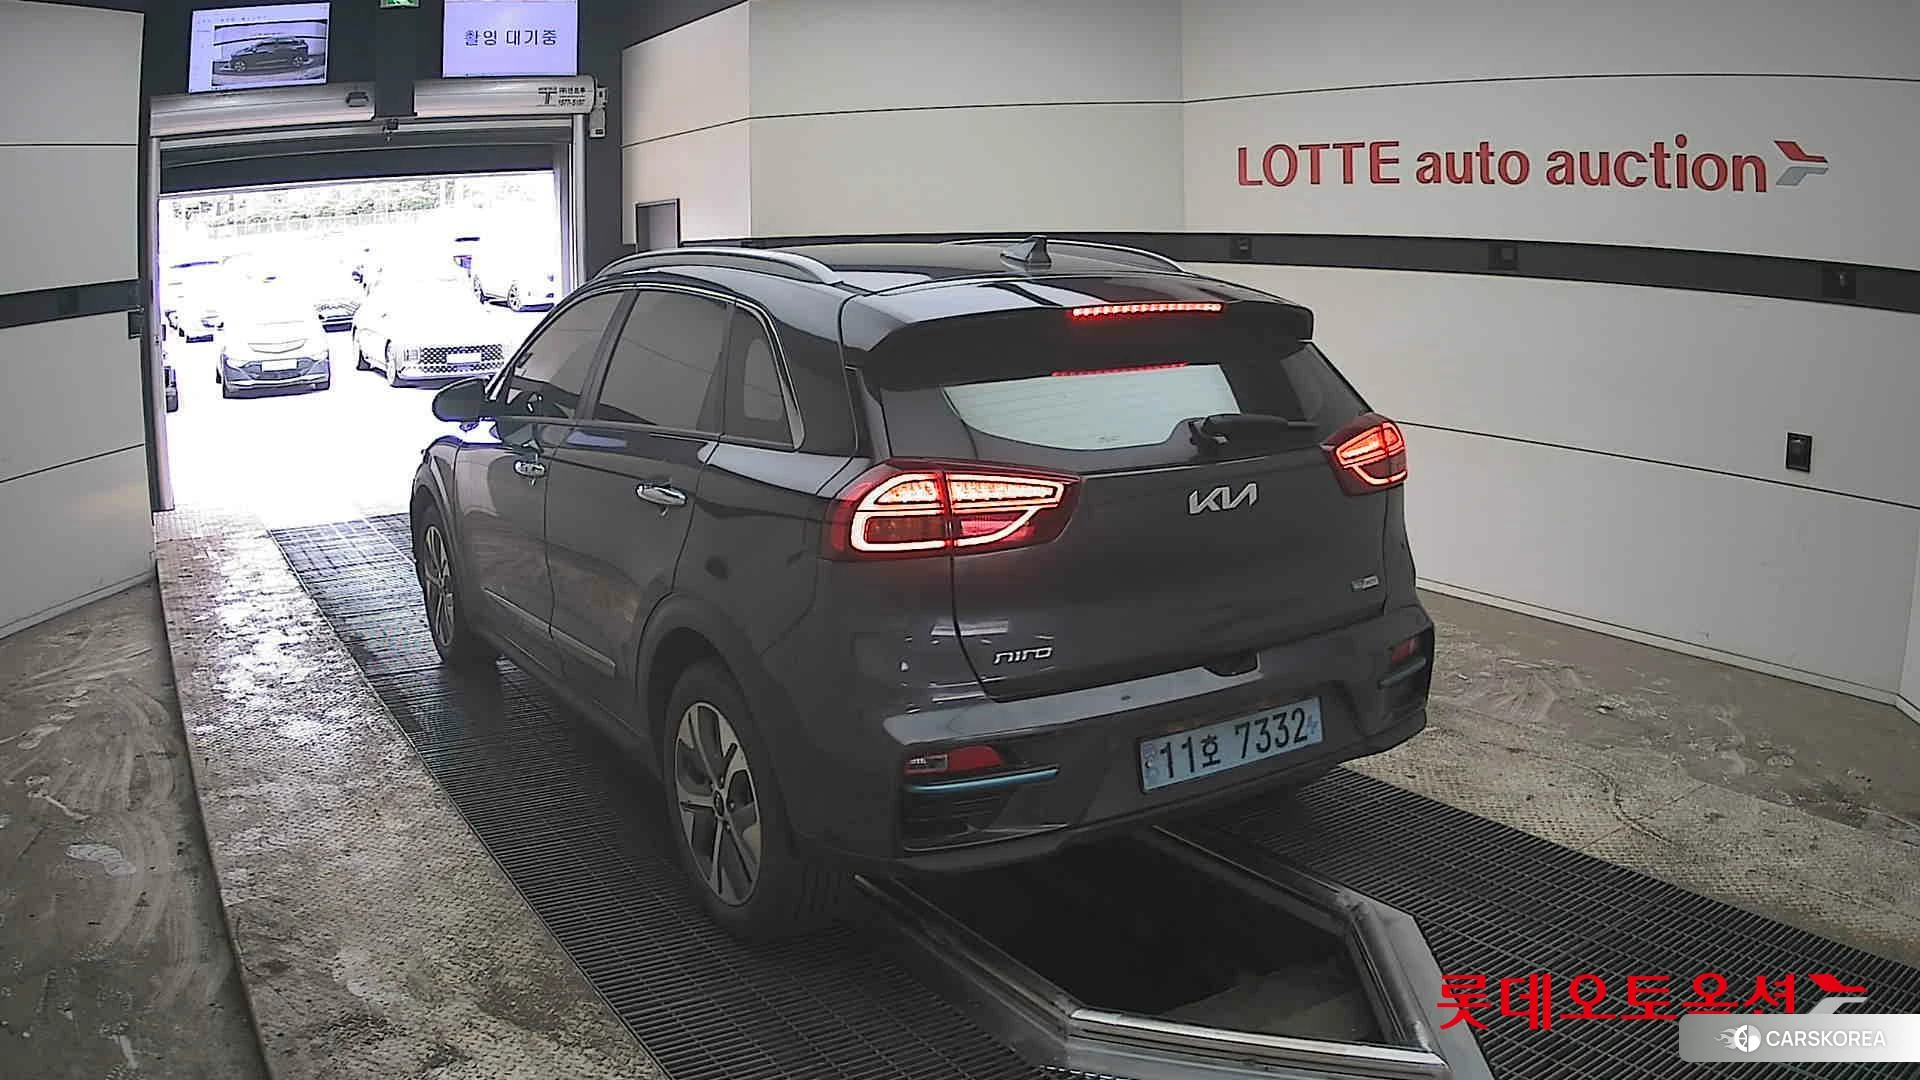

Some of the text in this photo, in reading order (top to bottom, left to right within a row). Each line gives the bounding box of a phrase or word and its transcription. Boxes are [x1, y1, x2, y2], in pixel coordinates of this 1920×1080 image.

[505, 29, 557, 46] 대기중
[1238, 134, 1768, 193] LOTTE auto auction
[1189, 483, 1257, 514] KIA
[1160, 707, 1308, 779] 11호 7332
